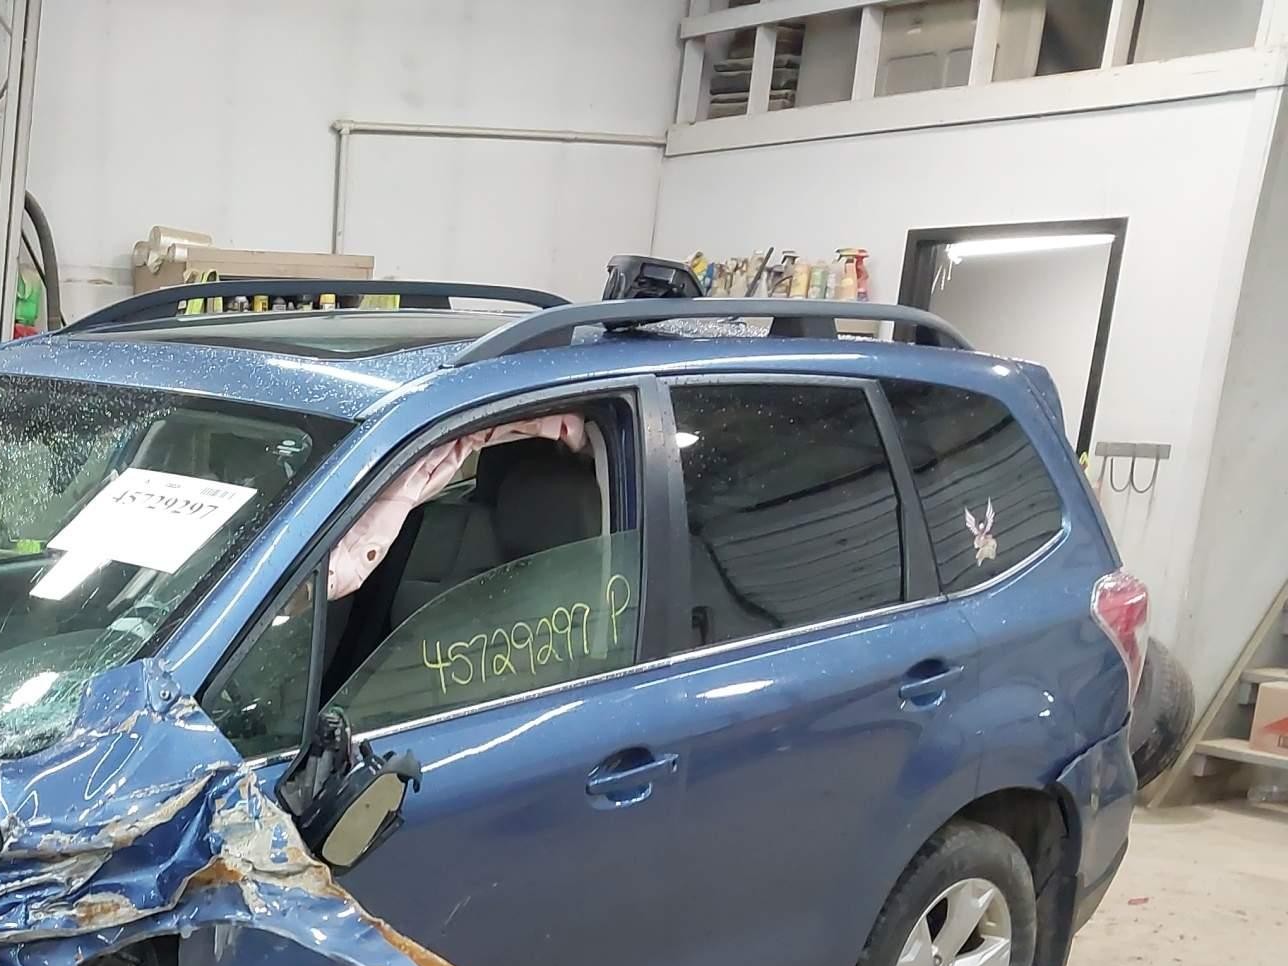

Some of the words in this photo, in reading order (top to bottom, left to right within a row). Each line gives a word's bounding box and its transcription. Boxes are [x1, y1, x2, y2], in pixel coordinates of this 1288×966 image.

[112, 489, 219, 519] 45729297
[423, 603, 591, 695] 45729297
[606, 574, 631, 644] P
